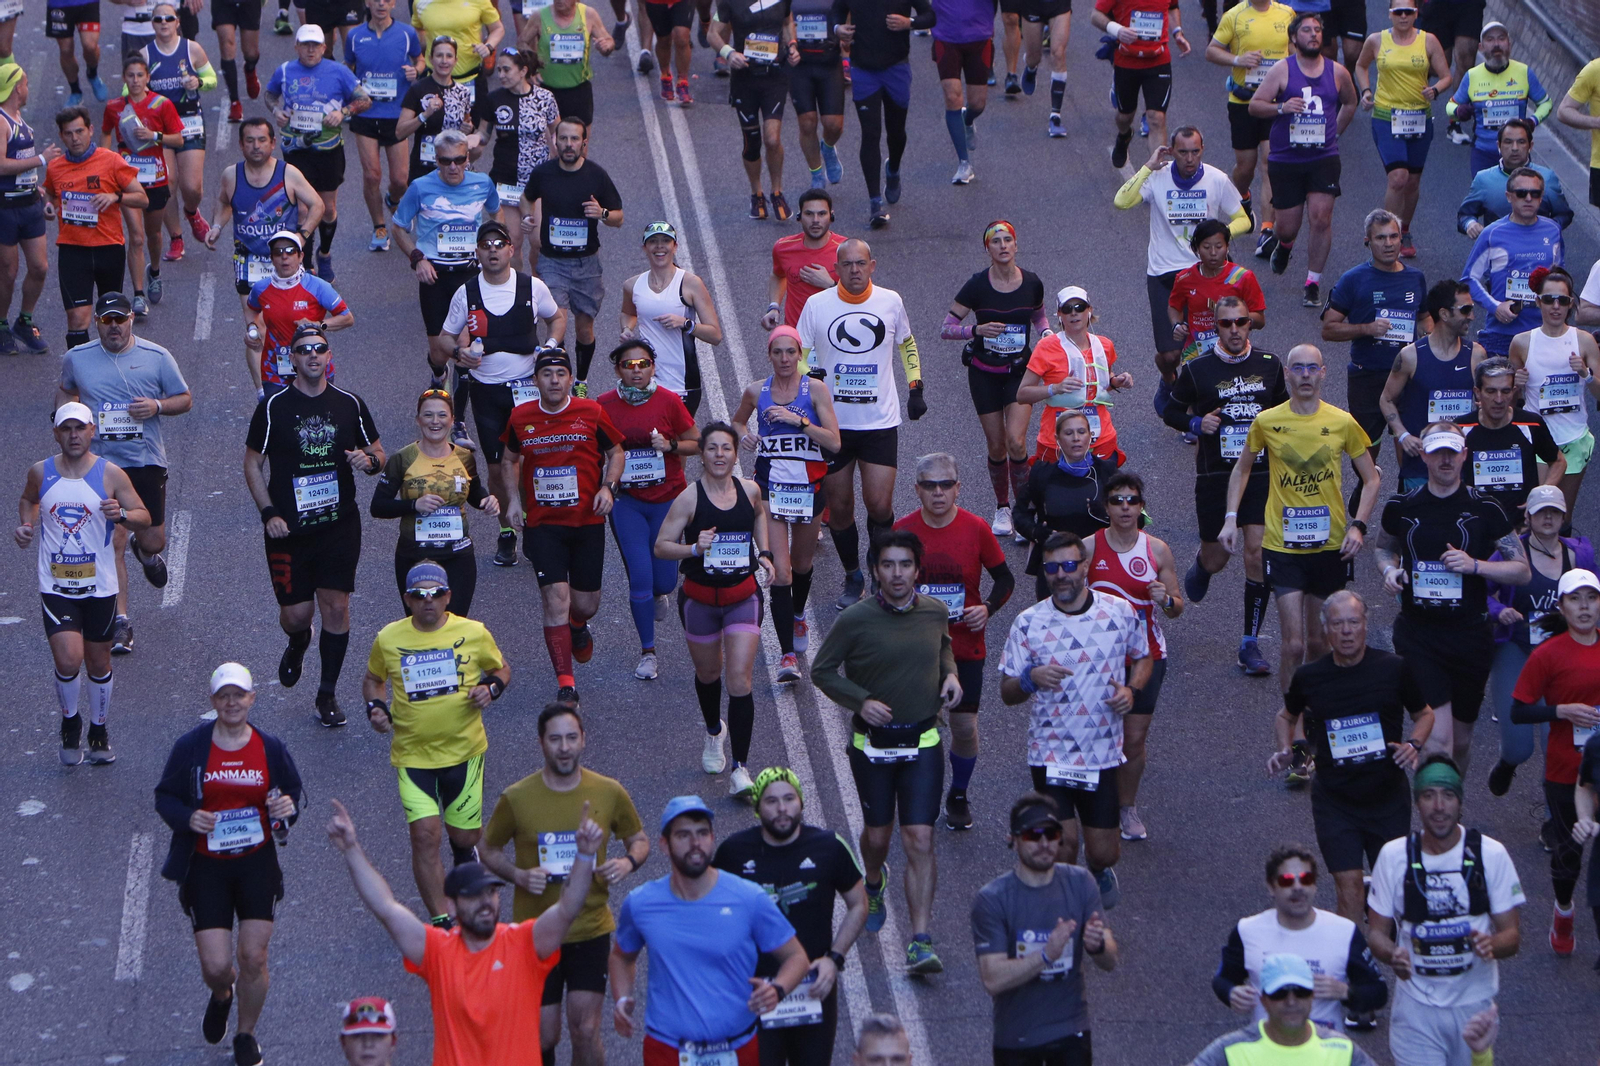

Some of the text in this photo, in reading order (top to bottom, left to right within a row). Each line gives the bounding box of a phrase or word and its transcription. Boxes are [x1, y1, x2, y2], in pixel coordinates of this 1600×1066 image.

[308, 474, 334, 484] ZURICH
[308, 488, 329, 497] 12478
[300, 502, 317, 510] JAVIER
[1425, 578, 1449, 586] 14000
[418, 652, 448, 662] ZURICH
[417, 666, 442, 677] 11784
[415, 679, 446, 690] FERNANDO
[1342, 715, 1373, 728] ZURICH
[1342, 732, 1368, 743] 12818
[204, 769, 264, 782] DANMARK
[224, 808, 253, 820] ZURICH
[222, 825, 248, 835] 13546
[220, 837, 252, 847] MARIANNE
[1429, 926, 1464, 936] ZURICH
[777, 1006, 806, 1015] JUANCAR
